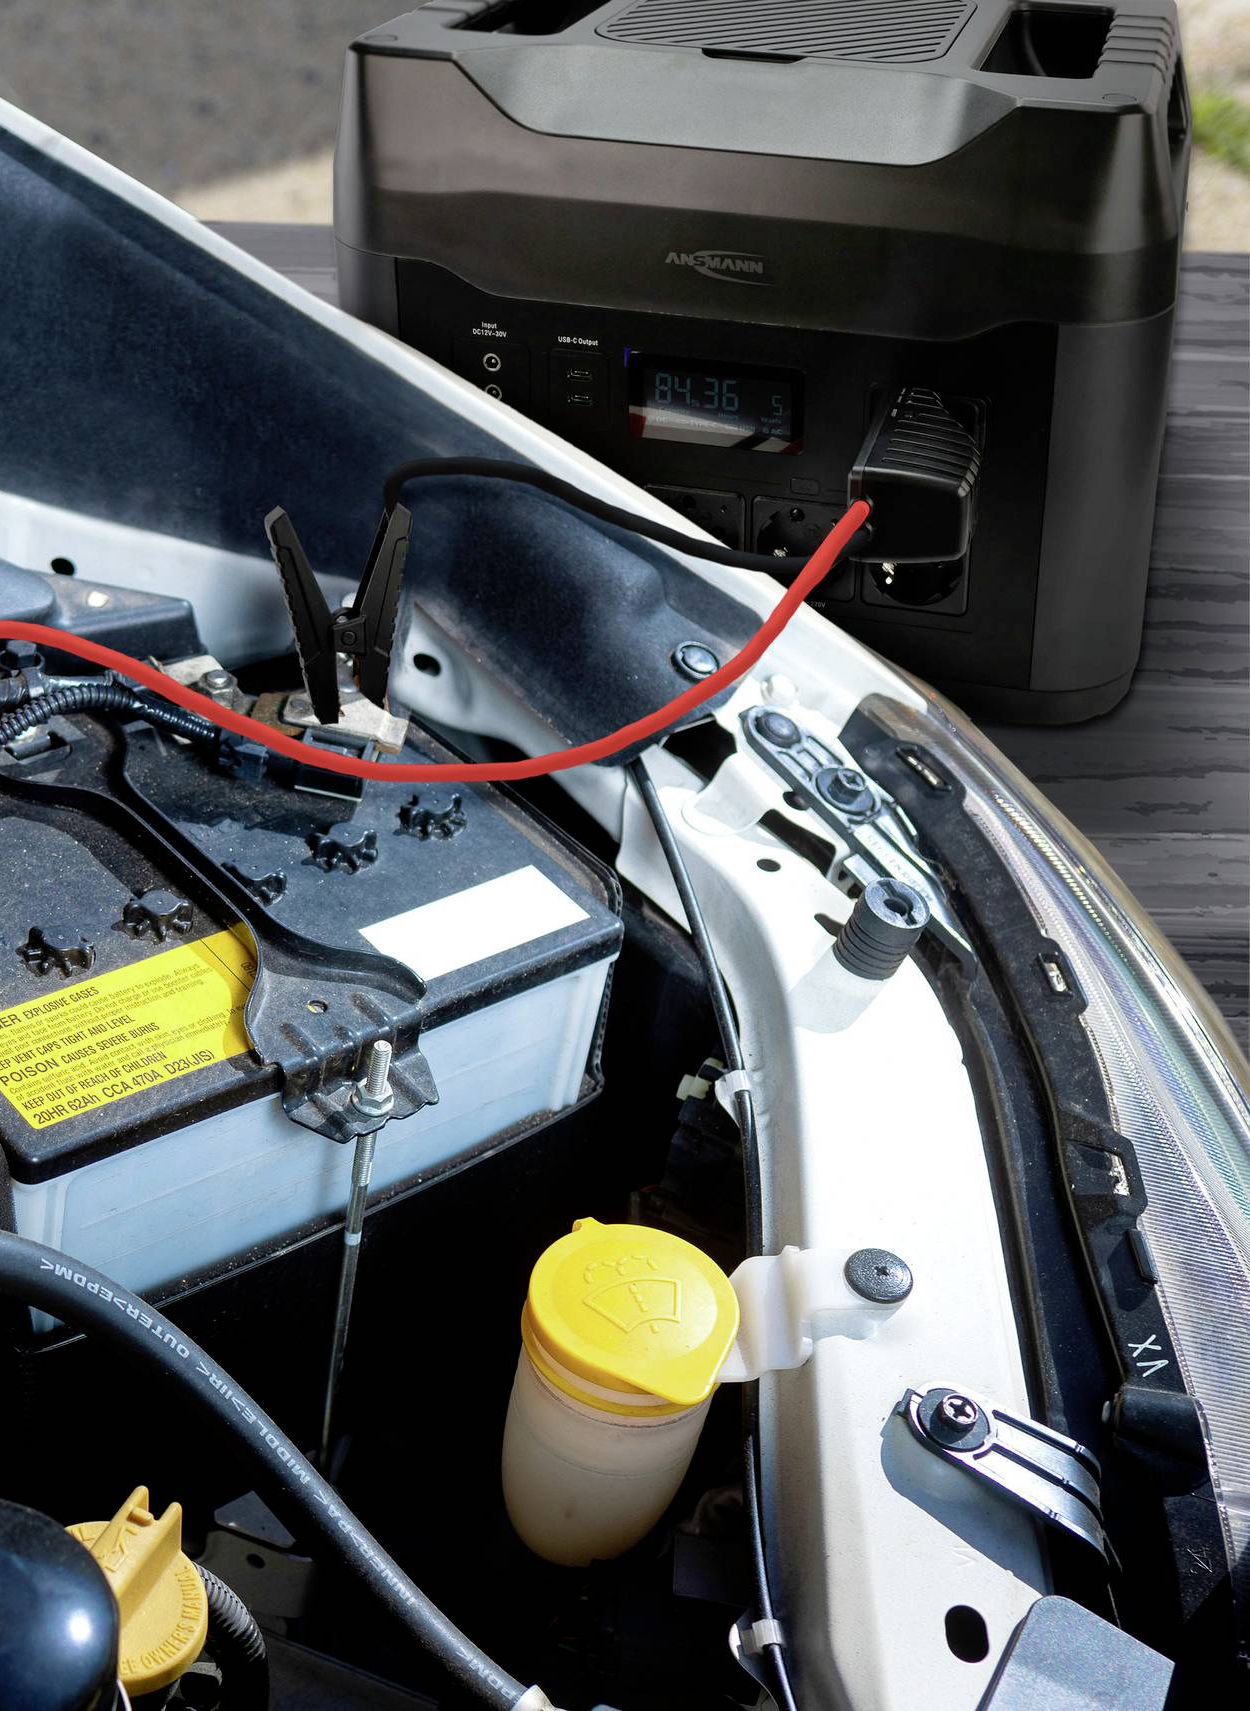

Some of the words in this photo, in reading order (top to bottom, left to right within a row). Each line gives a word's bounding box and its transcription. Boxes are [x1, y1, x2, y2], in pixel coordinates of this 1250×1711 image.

[665, 251, 765, 277] ANSMANN
[481, 321, 498, 330] Input
[557, 335, 577, 344] USB-C
[578, 338, 599, 346] Output
[655, 372, 739, 411] 84.36
[21, 997, 71, 1019] EXPLOSIVE
[68, 986, 100, 1002] GASES
[11, 1050, 38, 1064] VENT
[35, 1040, 62, 1055] CAPS
[59, 1031, 88, 1046] TIGHT
[86, 1023, 108, 1036] AND
[106, 1013, 135, 1029] LEVEL
[60, 1046, 97, 1063] CAUSES
[95, 1033, 130, 1050] SEVERE
[128, 1022, 160, 1038] BURNS
[21, 1096, 47, 1110] KEEP
[44, 1088, 66, 1101] OUT
[64, 1083, 80, 1094] OF
[77, 1072, 111, 1089] REACH
[108, 1067, 124, 1078] OF
[120, 1051, 168, 1073] CHILDREN
[31, 1104, 70, 1124] 20HR
[65, 1092, 101, 1111] 62Ah
[100, 1080, 133, 1098] CCA
[129, 1068, 164, 1087] 470A
[162, 1048, 216, 1074] D23(JIS)
[140, 1623, 196, 1669] OWNER'S
